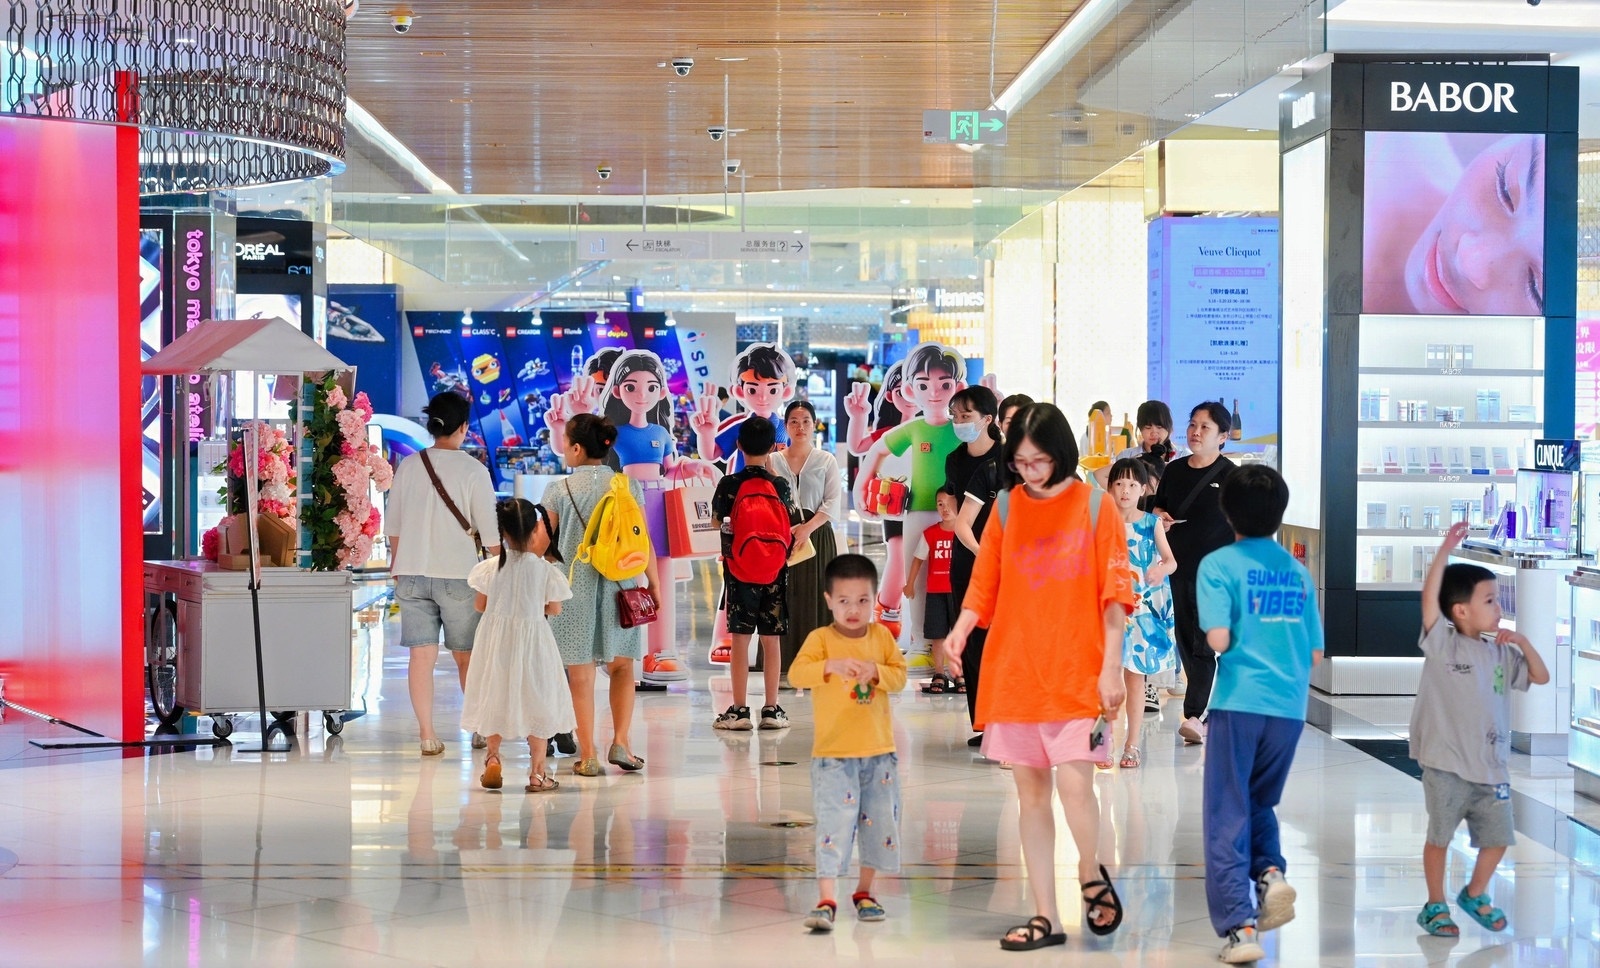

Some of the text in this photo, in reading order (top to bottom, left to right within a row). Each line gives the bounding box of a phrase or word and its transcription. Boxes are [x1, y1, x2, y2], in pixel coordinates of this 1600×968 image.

[1390, 81, 1518, 113] BABOR
[745, 240, 776, 248] 总服务台
[1198, 246, 1261, 258] Veuve Clicquot
[183, 229, 203, 291] tokyo
[607, 329, 628, 338] duplo
[1536, 443, 1564, 470] CLINIQUE
[936, 540, 953, 549] FU
